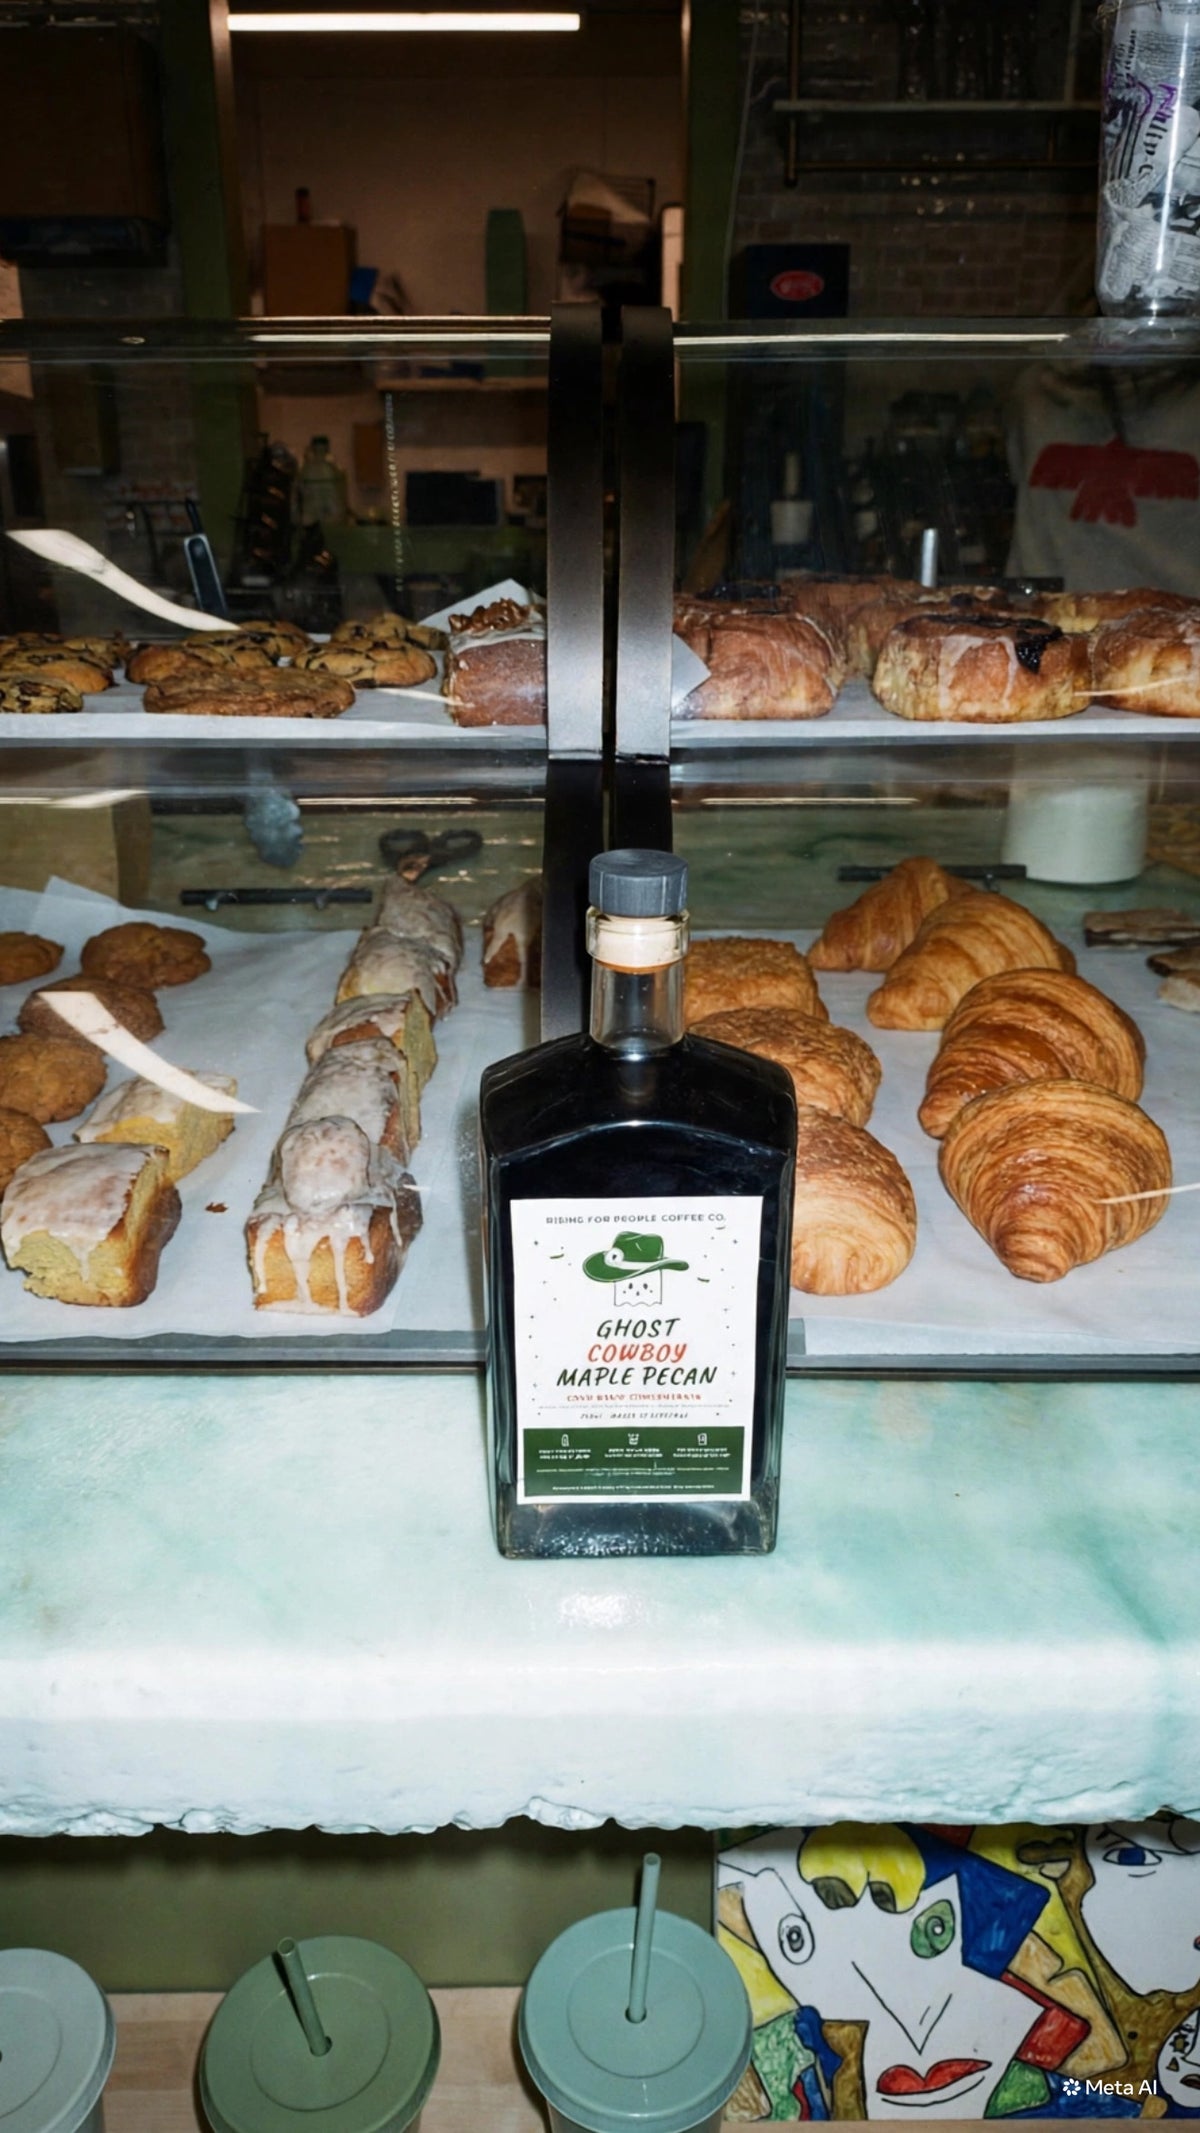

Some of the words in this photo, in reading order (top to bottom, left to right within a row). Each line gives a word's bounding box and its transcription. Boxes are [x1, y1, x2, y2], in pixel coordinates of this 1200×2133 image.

[660, 1213, 705, 1222] COFFEE
[596, 1317, 681, 1340] GHOST
[587, 1342, 688, 1364] COWBOY
[556, 1366, 635, 1388] MAPLE
[642, 1365, 718, 1387] PECAN
